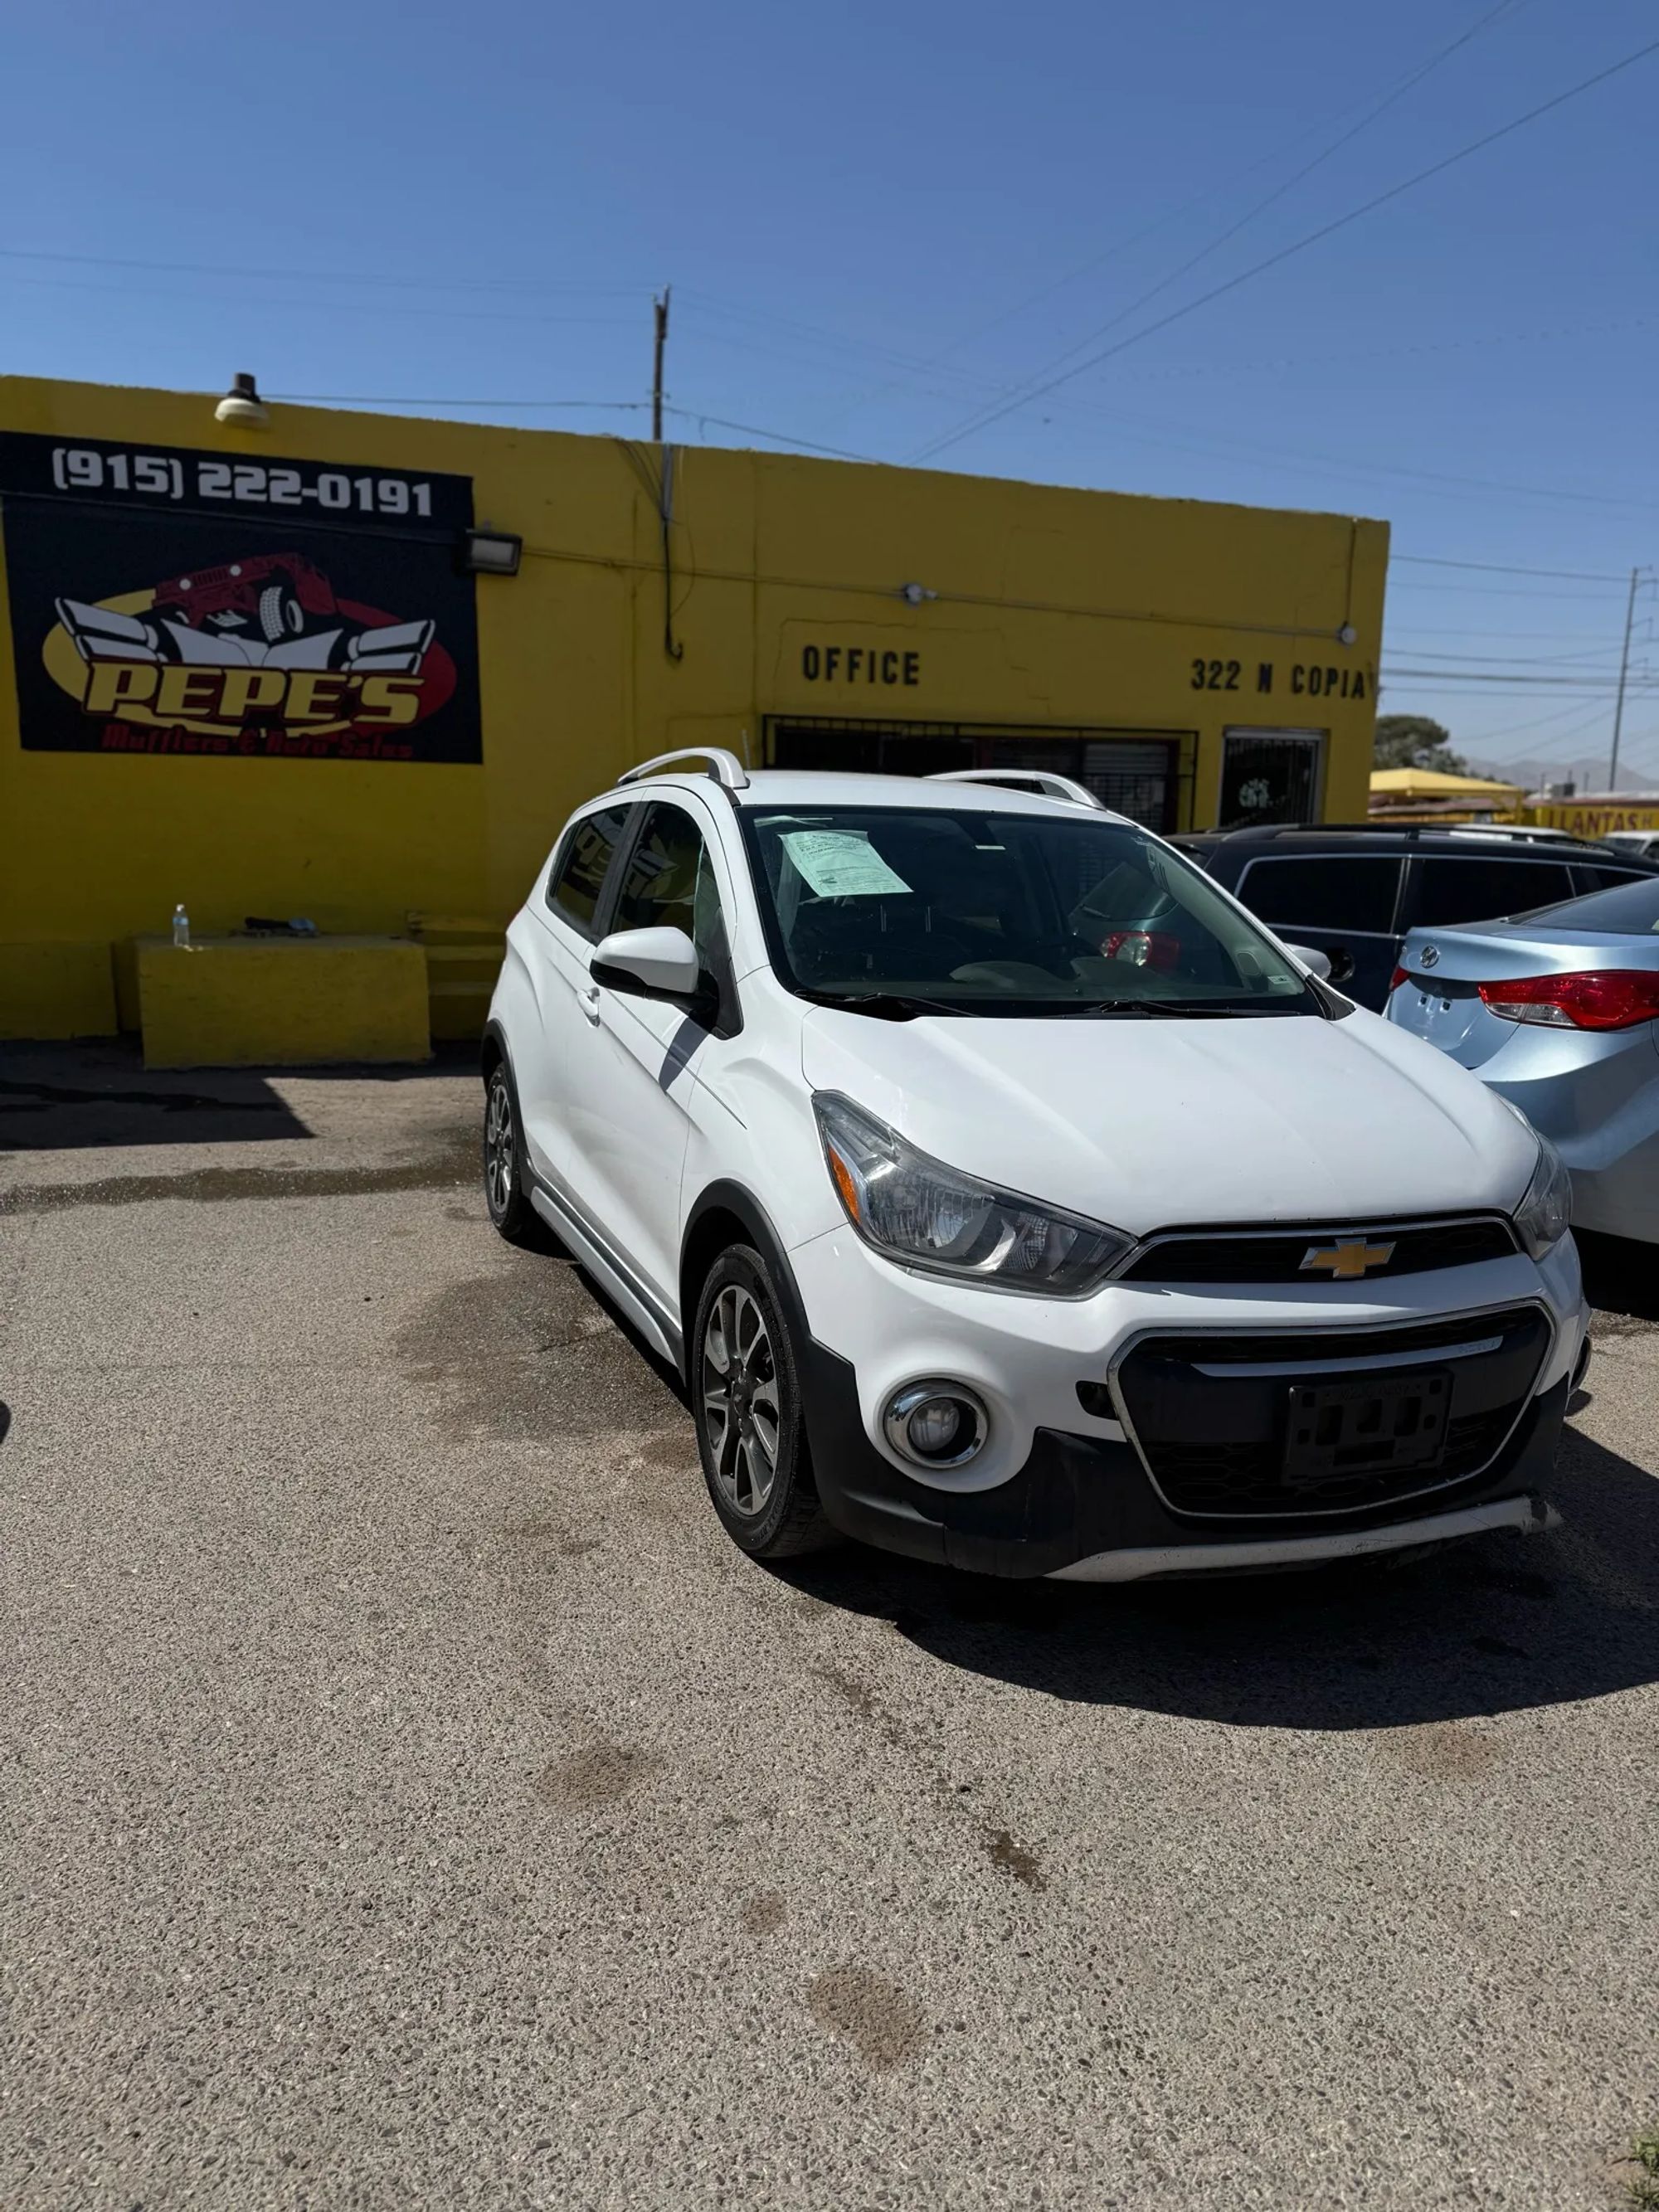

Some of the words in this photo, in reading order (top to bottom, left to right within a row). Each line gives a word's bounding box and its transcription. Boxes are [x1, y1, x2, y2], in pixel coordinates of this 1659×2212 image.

[52, 449, 183, 498] (915)
[198, 462, 431, 516] 222-0191
[802, 645, 920, 686] OFFICE
[1191, 659, 1241, 690] 322
[1257, 663, 1272, 693] N
[1291, 664, 1365, 699] COPIA
[86, 662, 424, 725] PEPE'S
[100, 723, 230, 753] Mufflers
[265, 730, 328, 756] Auto
[338, 732, 413, 759] Sales
